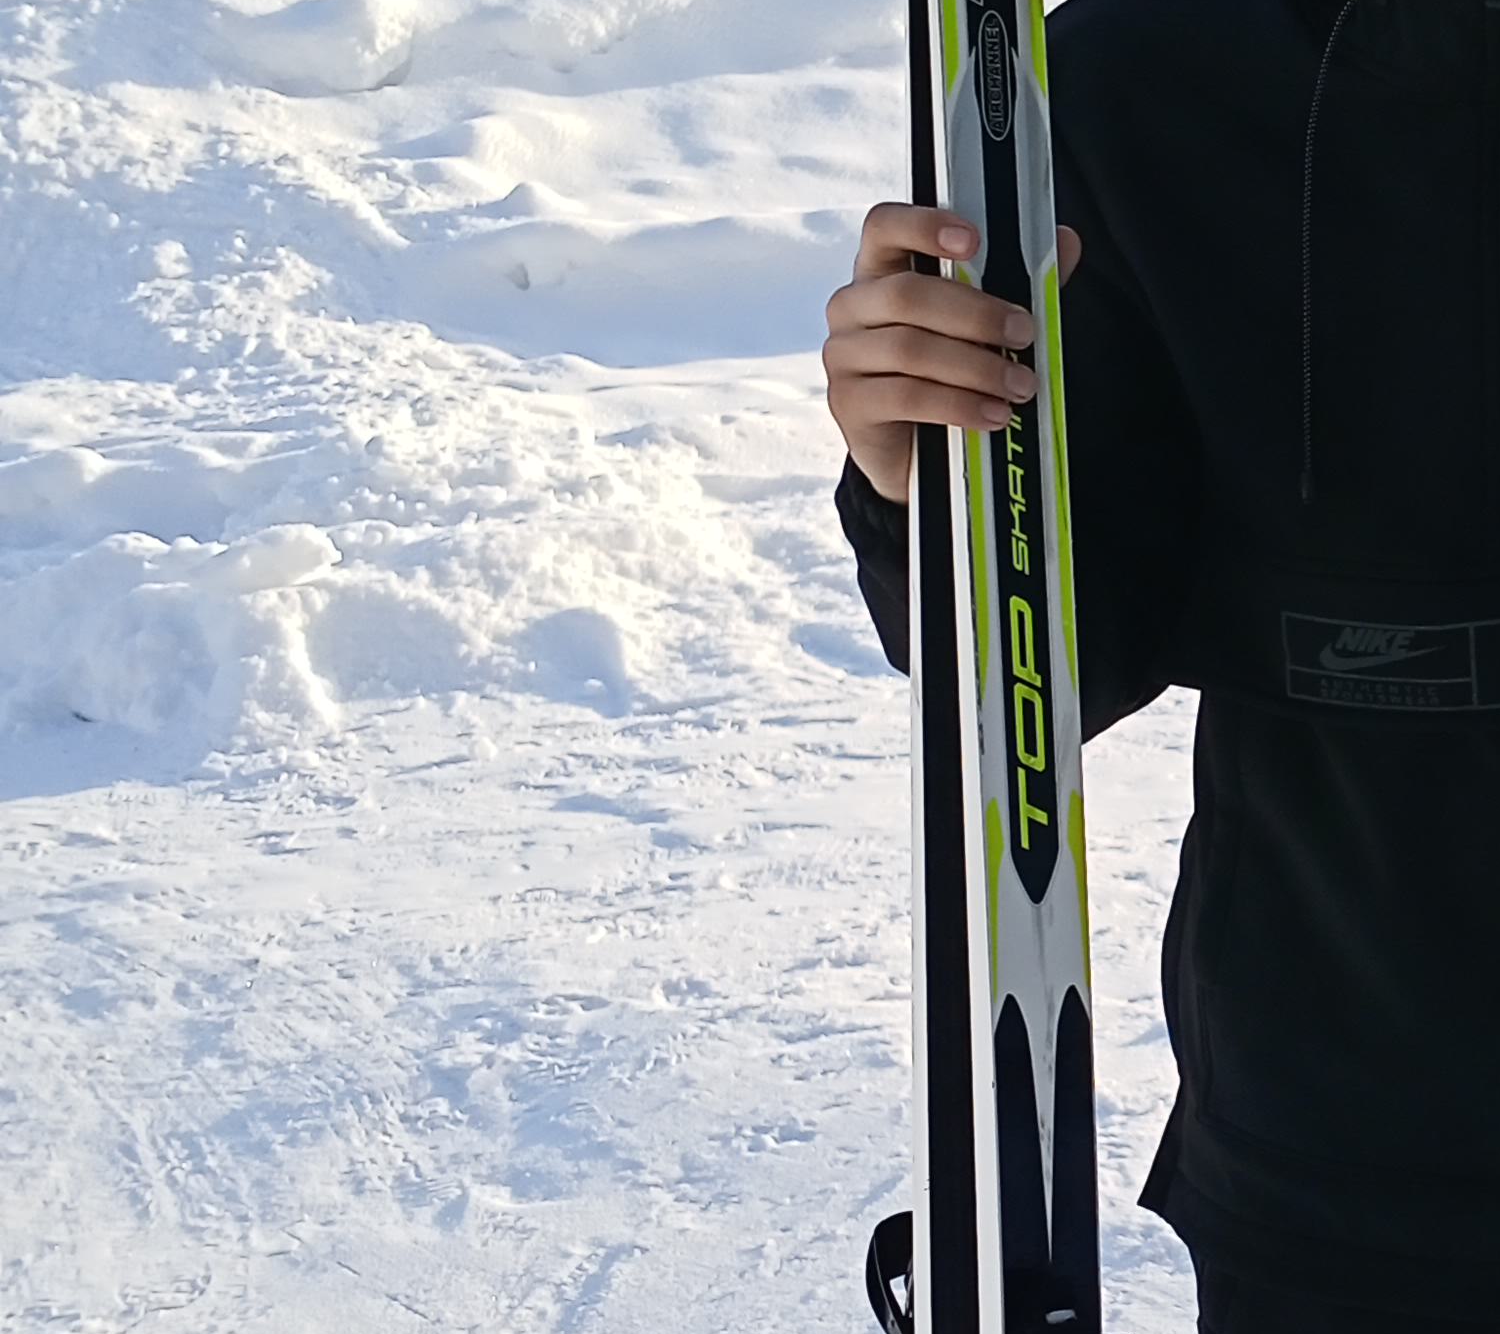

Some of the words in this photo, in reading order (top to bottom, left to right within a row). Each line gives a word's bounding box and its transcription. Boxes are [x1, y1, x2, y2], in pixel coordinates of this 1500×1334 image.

[1002, 351, 1030, 576] SKATI
[1010, 594, 1048, 850] TOP
[1333, 625, 1416, 658] NIKE
